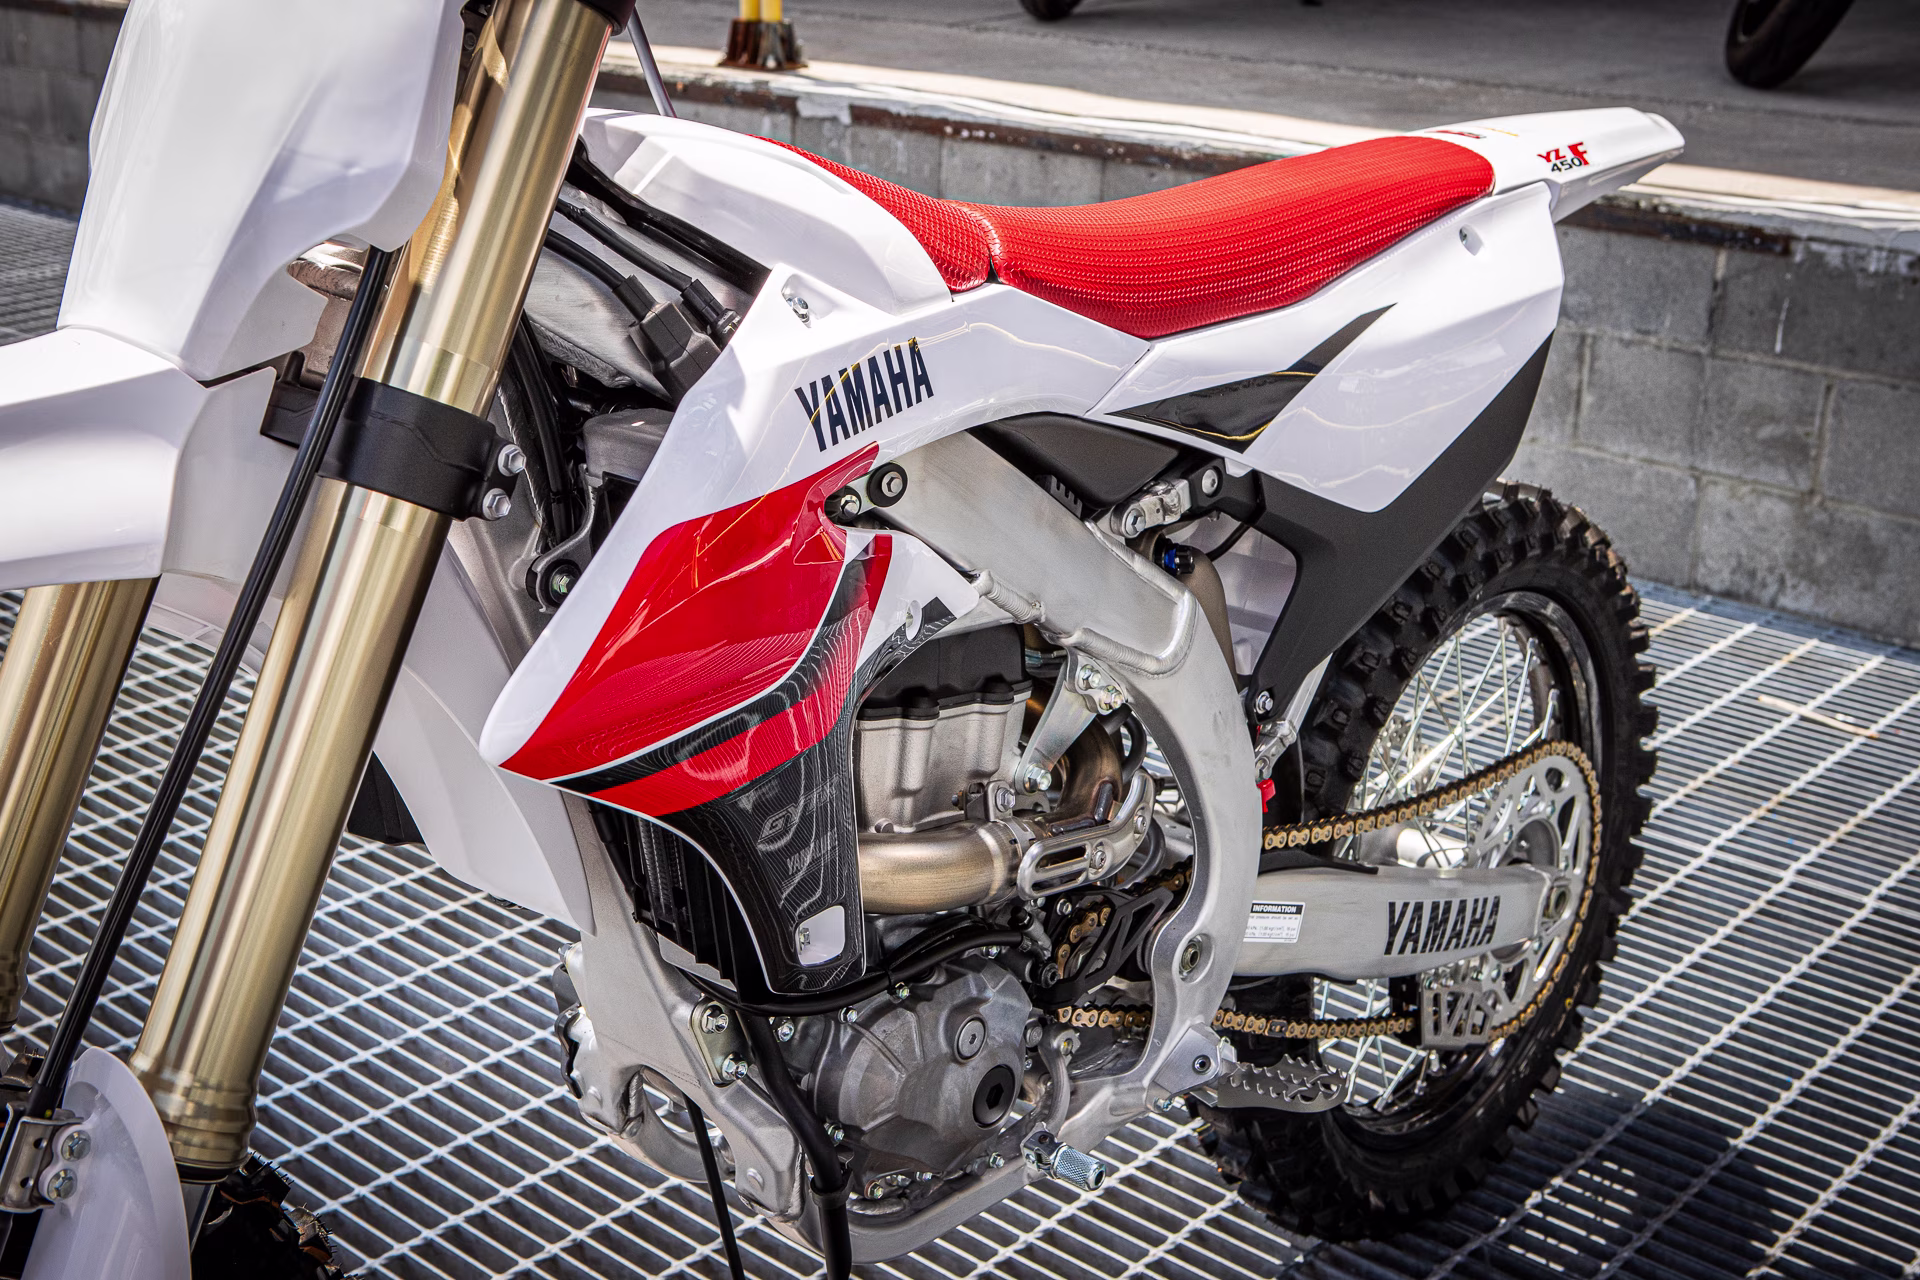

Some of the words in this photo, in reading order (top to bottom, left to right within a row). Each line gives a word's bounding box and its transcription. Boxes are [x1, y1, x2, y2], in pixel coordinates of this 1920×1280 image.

[1551, 157, 1583, 172] 450
[794, 336, 934, 453] YAMAHA
[1252, 904, 1297, 913] INFORMATION
[1383, 895, 1501, 956] YAMAHA
